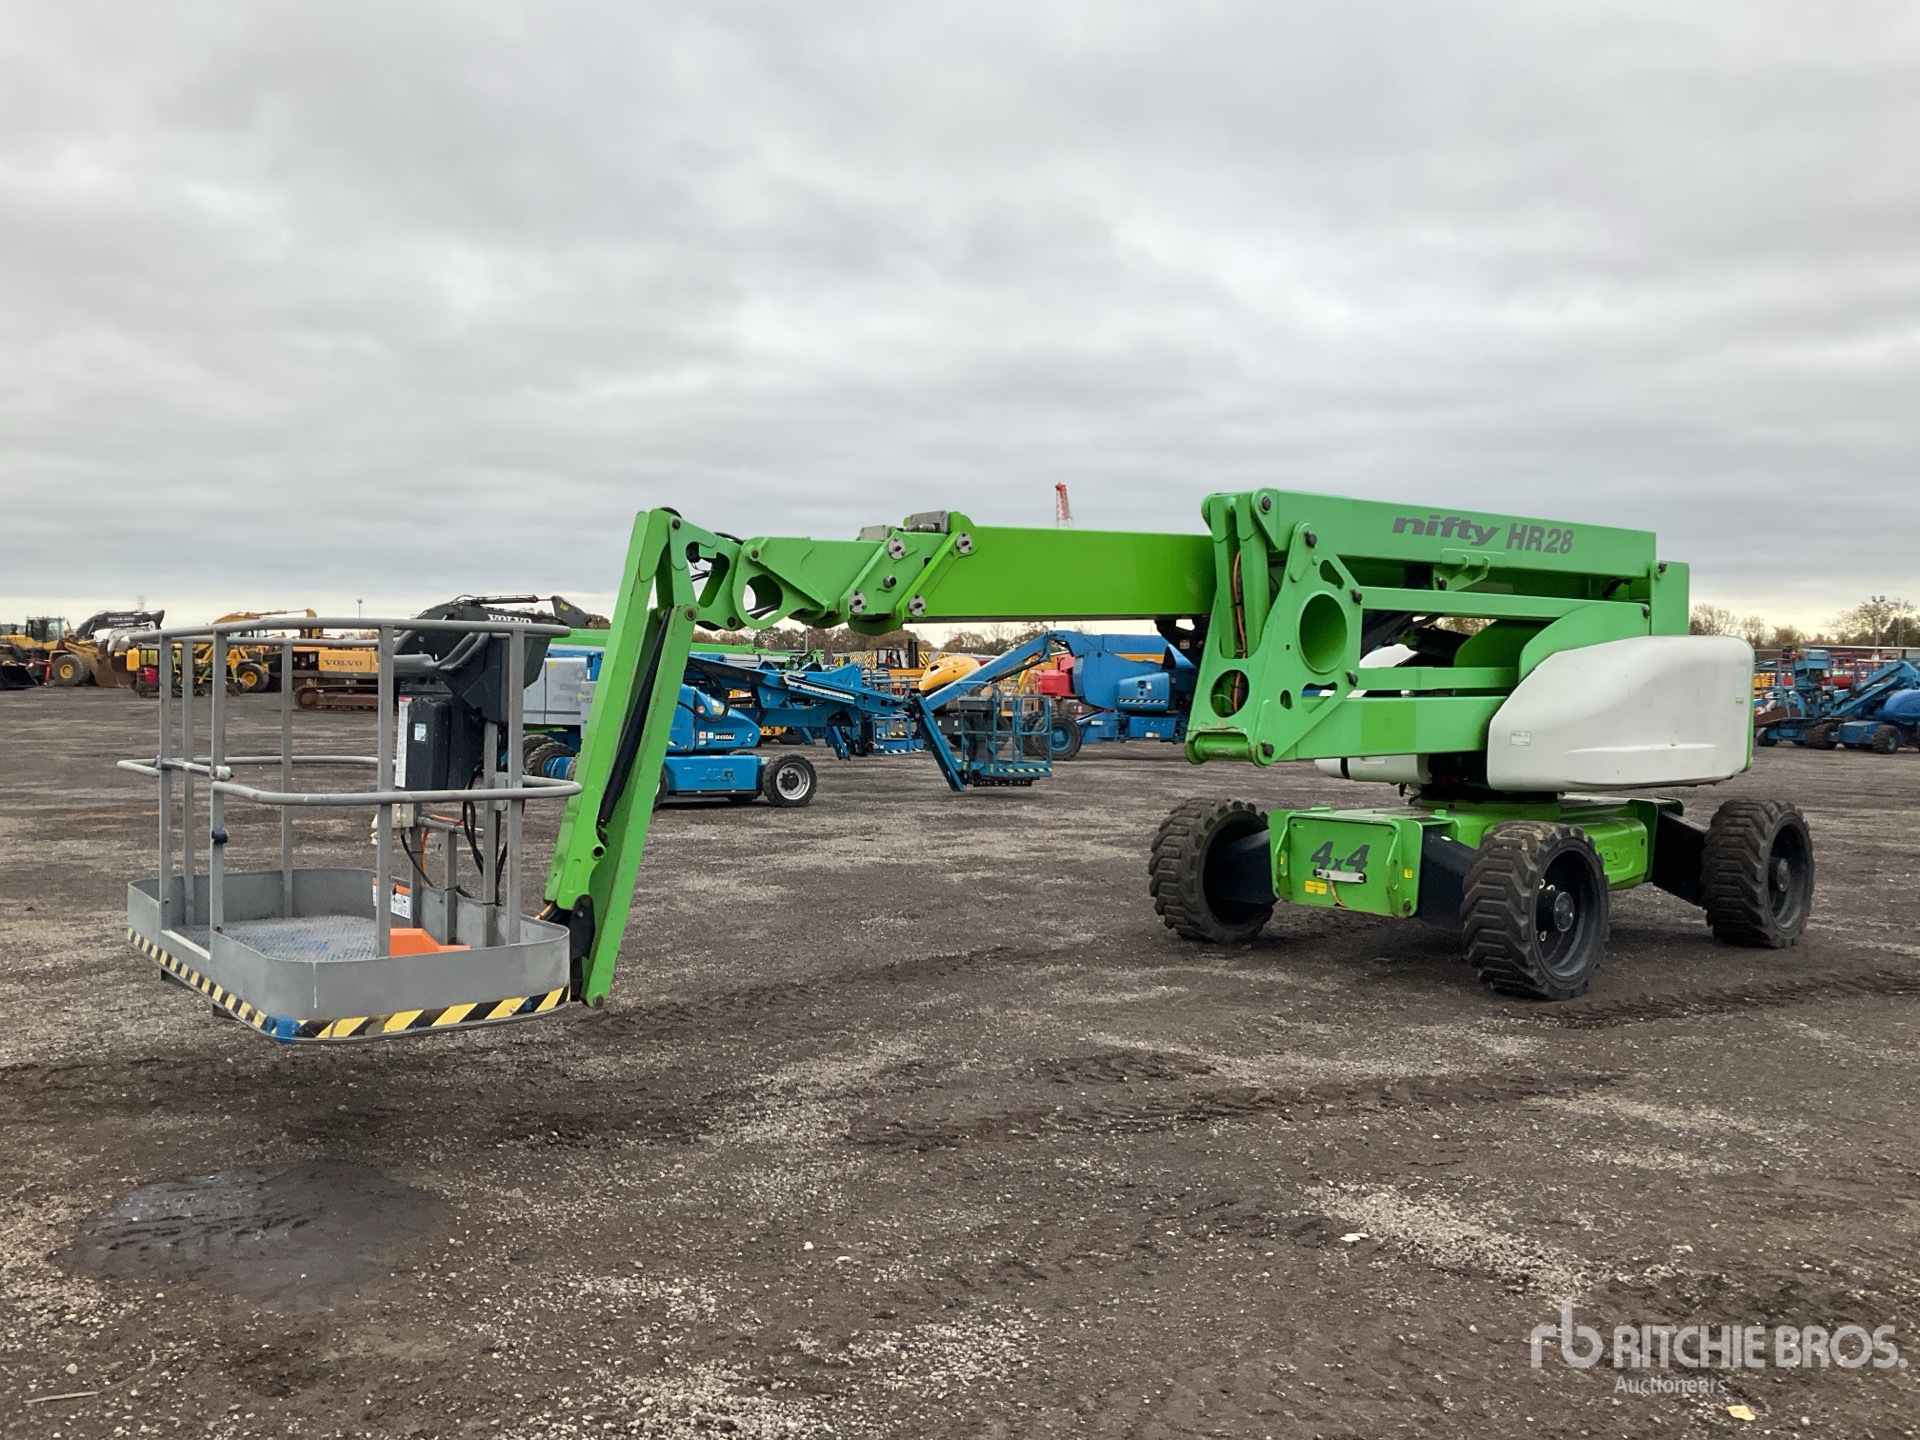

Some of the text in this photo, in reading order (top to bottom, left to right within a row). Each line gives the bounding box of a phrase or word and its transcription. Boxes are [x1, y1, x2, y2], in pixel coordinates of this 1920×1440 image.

[1392, 514, 1575, 555] nifty HR28
[324, 659, 363, 667] VOLVO
[1310, 841, 1371, 873] 4x4
